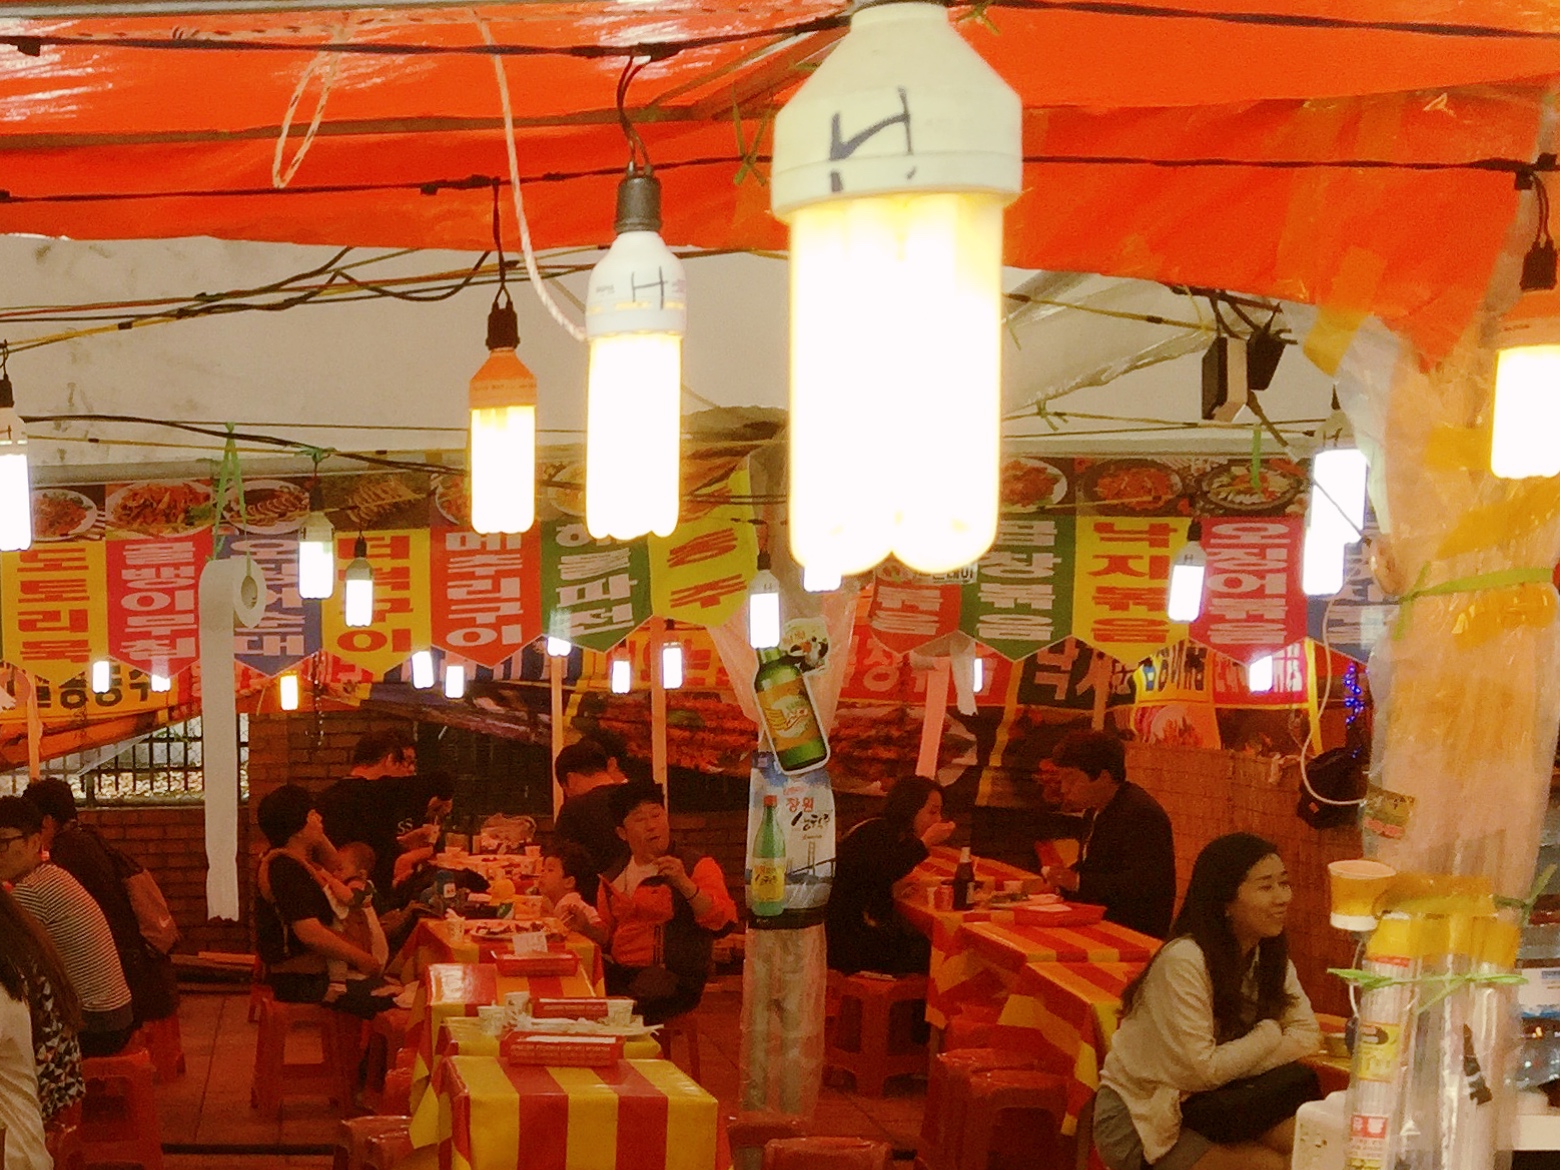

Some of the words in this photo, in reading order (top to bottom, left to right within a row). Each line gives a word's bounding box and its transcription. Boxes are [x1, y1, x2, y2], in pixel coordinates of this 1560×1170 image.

[17, 547, 91, 663] 도토리묵
[120, 541, 198, 661] 골뱅이무침
[445, 530, 524, 648] 메추리구이
[1088, 522, 1178, 643] 낙지볶음
[1206, 522, 1290, 645] 오징어볶음
